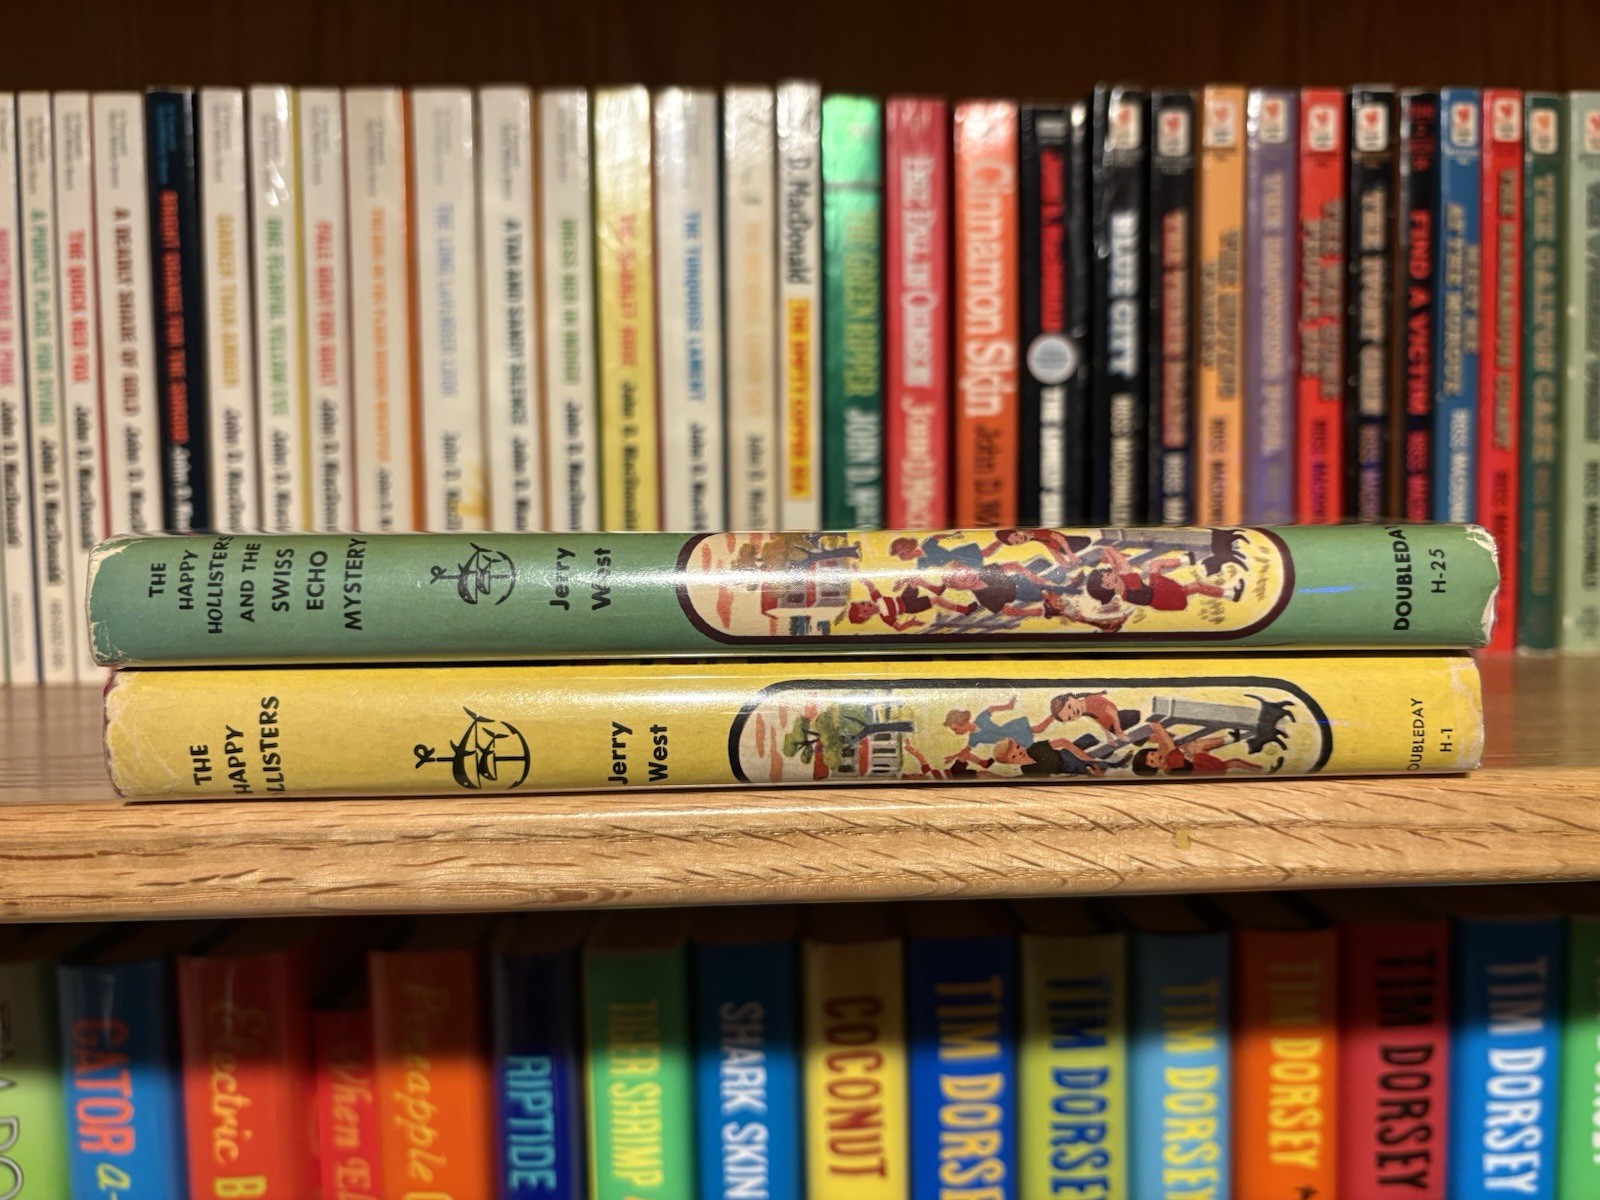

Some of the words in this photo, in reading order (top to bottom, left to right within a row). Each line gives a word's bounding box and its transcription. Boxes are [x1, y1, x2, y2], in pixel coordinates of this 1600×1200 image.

[788, 181, 813, 285] MacDonald
[964, 158, 1016, 336] Cinnamon
[1108, 212, 1139, 297] BLUE
[1408, 208, 1432, 280] FIND
[1408, 286, 1431, 308] A
[1108, 300, 1138, 378] CITY
[1408, 313, 1430, 415] VICTIM
[959, 339, 1019, 418] Skin
[149, 562, 166, 598] THE
[180, 549, 199, 610] HAPPY
[208, 536, 234, 634] HOLLISTERS
[242, 542, 261, 574] THE
[272, 548, 294, 612] SWISS
[306, 550, 328, 610] ECHO
[344, 538, 367, 630] MYSTERY
[550, 547, 576, 611] Jerry
[591, 547, 611, 611] West
[1385, 525, 1412, 631] DOUBLEDA
[1429, 548, 1447, 594] H-25
[240, 581, 255, 622] AND
[190, 744, 212, 786] THE
[225, 725, 253, 794] HAPPY
[608, 721, 633, 785] Jerry
[648, 724, 668, 782] West
[1440, 727, 1453, 752] H-1
[934, 975, 1003, 1061] TIM
[1048, 975, 1110, 1050] TIM
[1161, 978, 1219, 1052] TIM
[1267, 960, 1321, 1027] TIM
[1376, 950, 1439, 1028] TIM
[1487, 957, 1548, 1035] TIM
[607, 1000, 660, 1077] TIGER
[718, 1001, 768, 1117] SHARK
[71, 1019, 136, 1155] GATOR
[207, 1001, 268, 1164] Electric
[823, 995, 889, 1180] COCONUT
[1267, 1037, 1324, 1169] DORSEY
[1375, 1043, 1436, 1190] DORSEY
[1482, 1046, 1547, 1194] DORSEY
[503, 1054, 557, 1191] RIPTIDE
[608, 1081, 665, 1188] SHRIMP
[720, 1121, 770, 1200] SKIN
